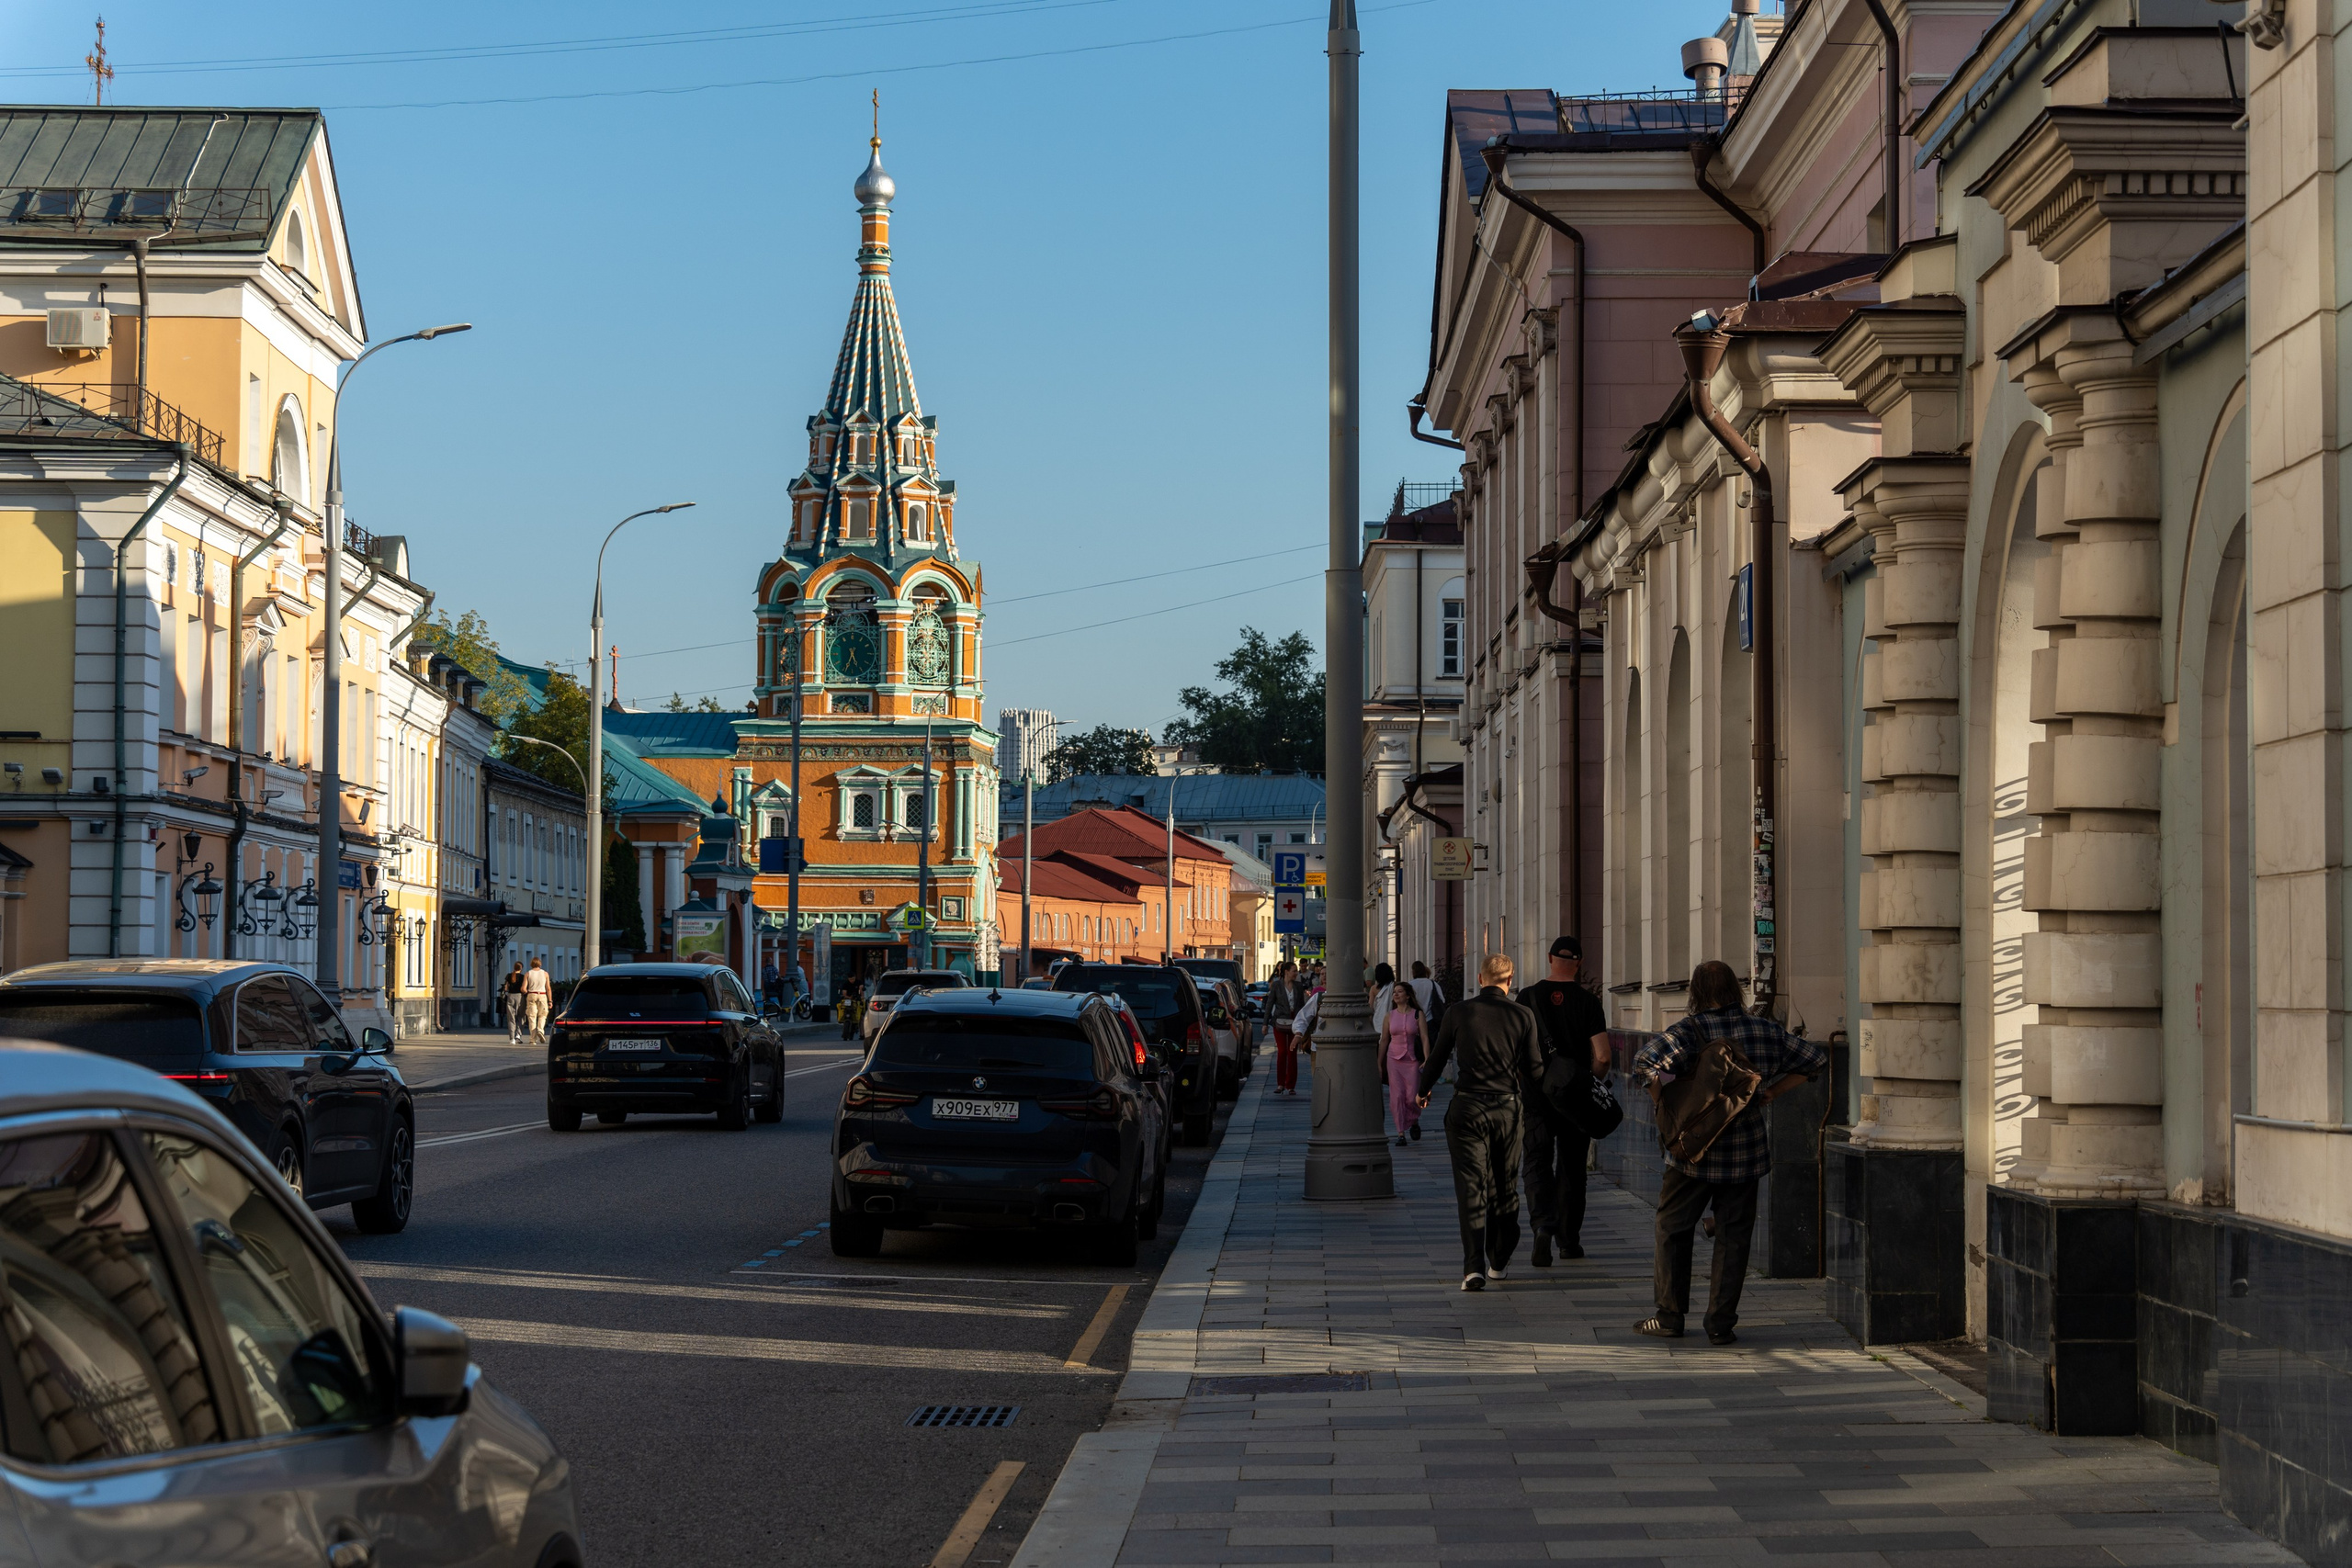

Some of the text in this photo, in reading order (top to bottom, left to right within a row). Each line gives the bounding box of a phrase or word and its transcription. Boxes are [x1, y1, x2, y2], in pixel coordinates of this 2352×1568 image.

[1283, 855, 1300, 881] P
[612, 1041, 644, 1049] Н145РТ
[936, 1100, 1015, 1116] Х909ЕХ 977
